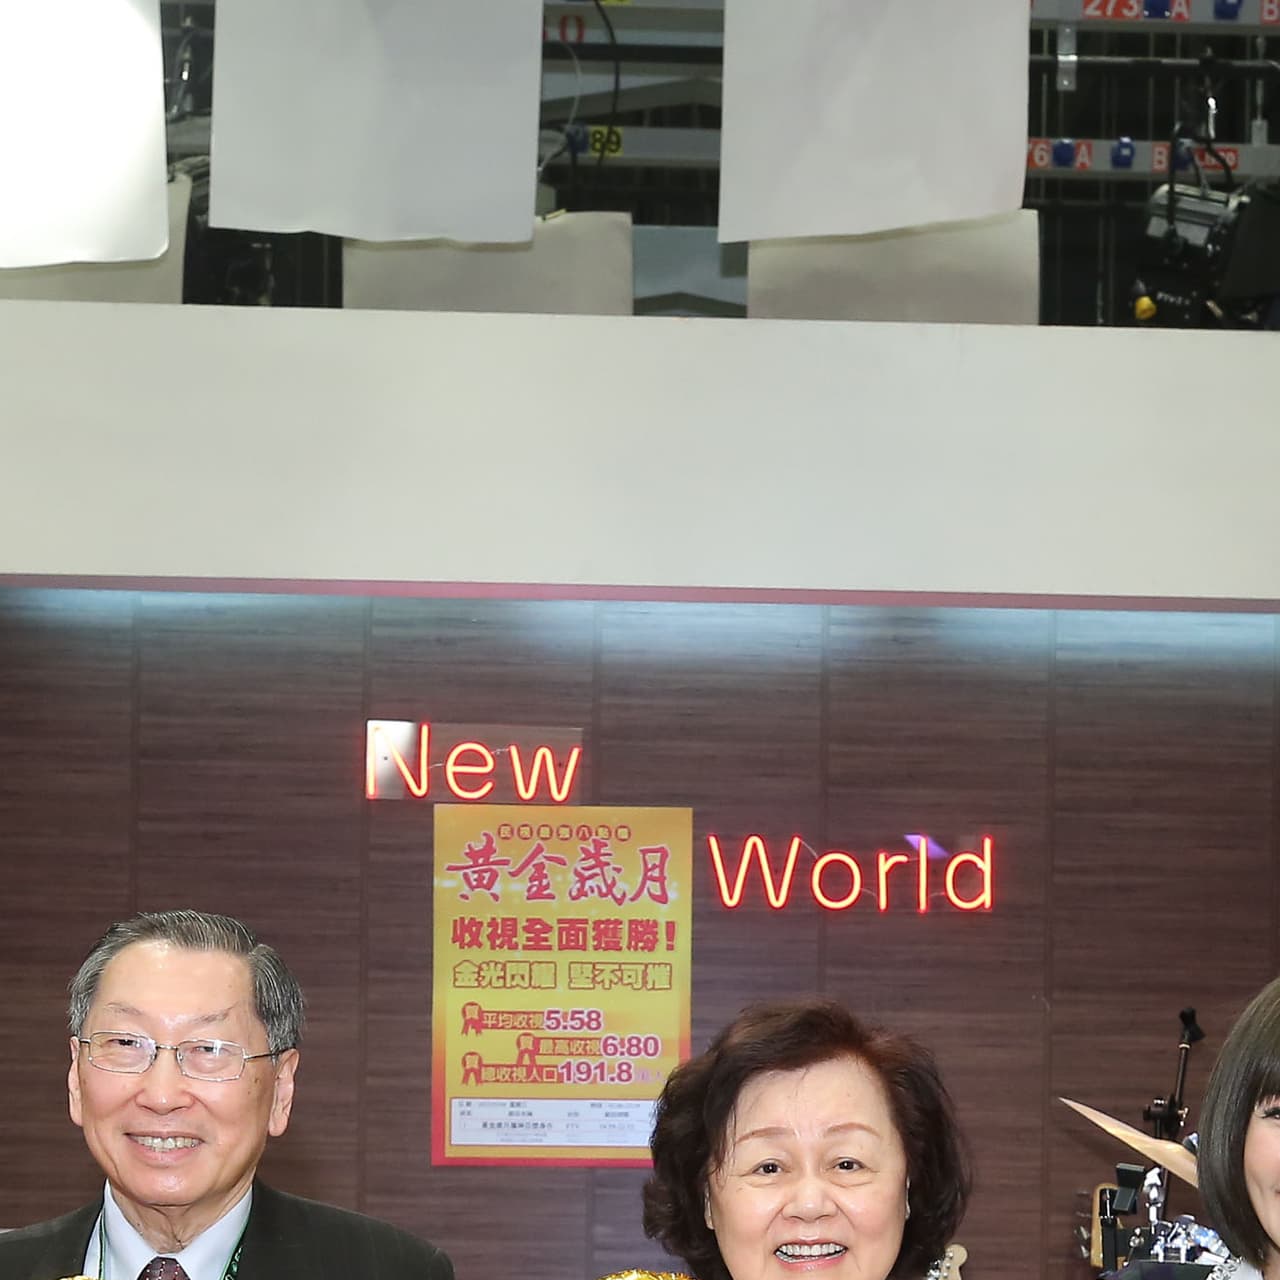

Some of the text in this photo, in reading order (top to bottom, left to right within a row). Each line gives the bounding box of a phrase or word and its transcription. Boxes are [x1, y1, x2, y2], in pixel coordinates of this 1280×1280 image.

[366, 723, 581, 801] New
[708, 834, 993, 912] World
[544, 1010, 603, 1032] 5.58
[601, 1035, 661, 1058] 6.80
[558, 1060, 633, 1083] 191.8
